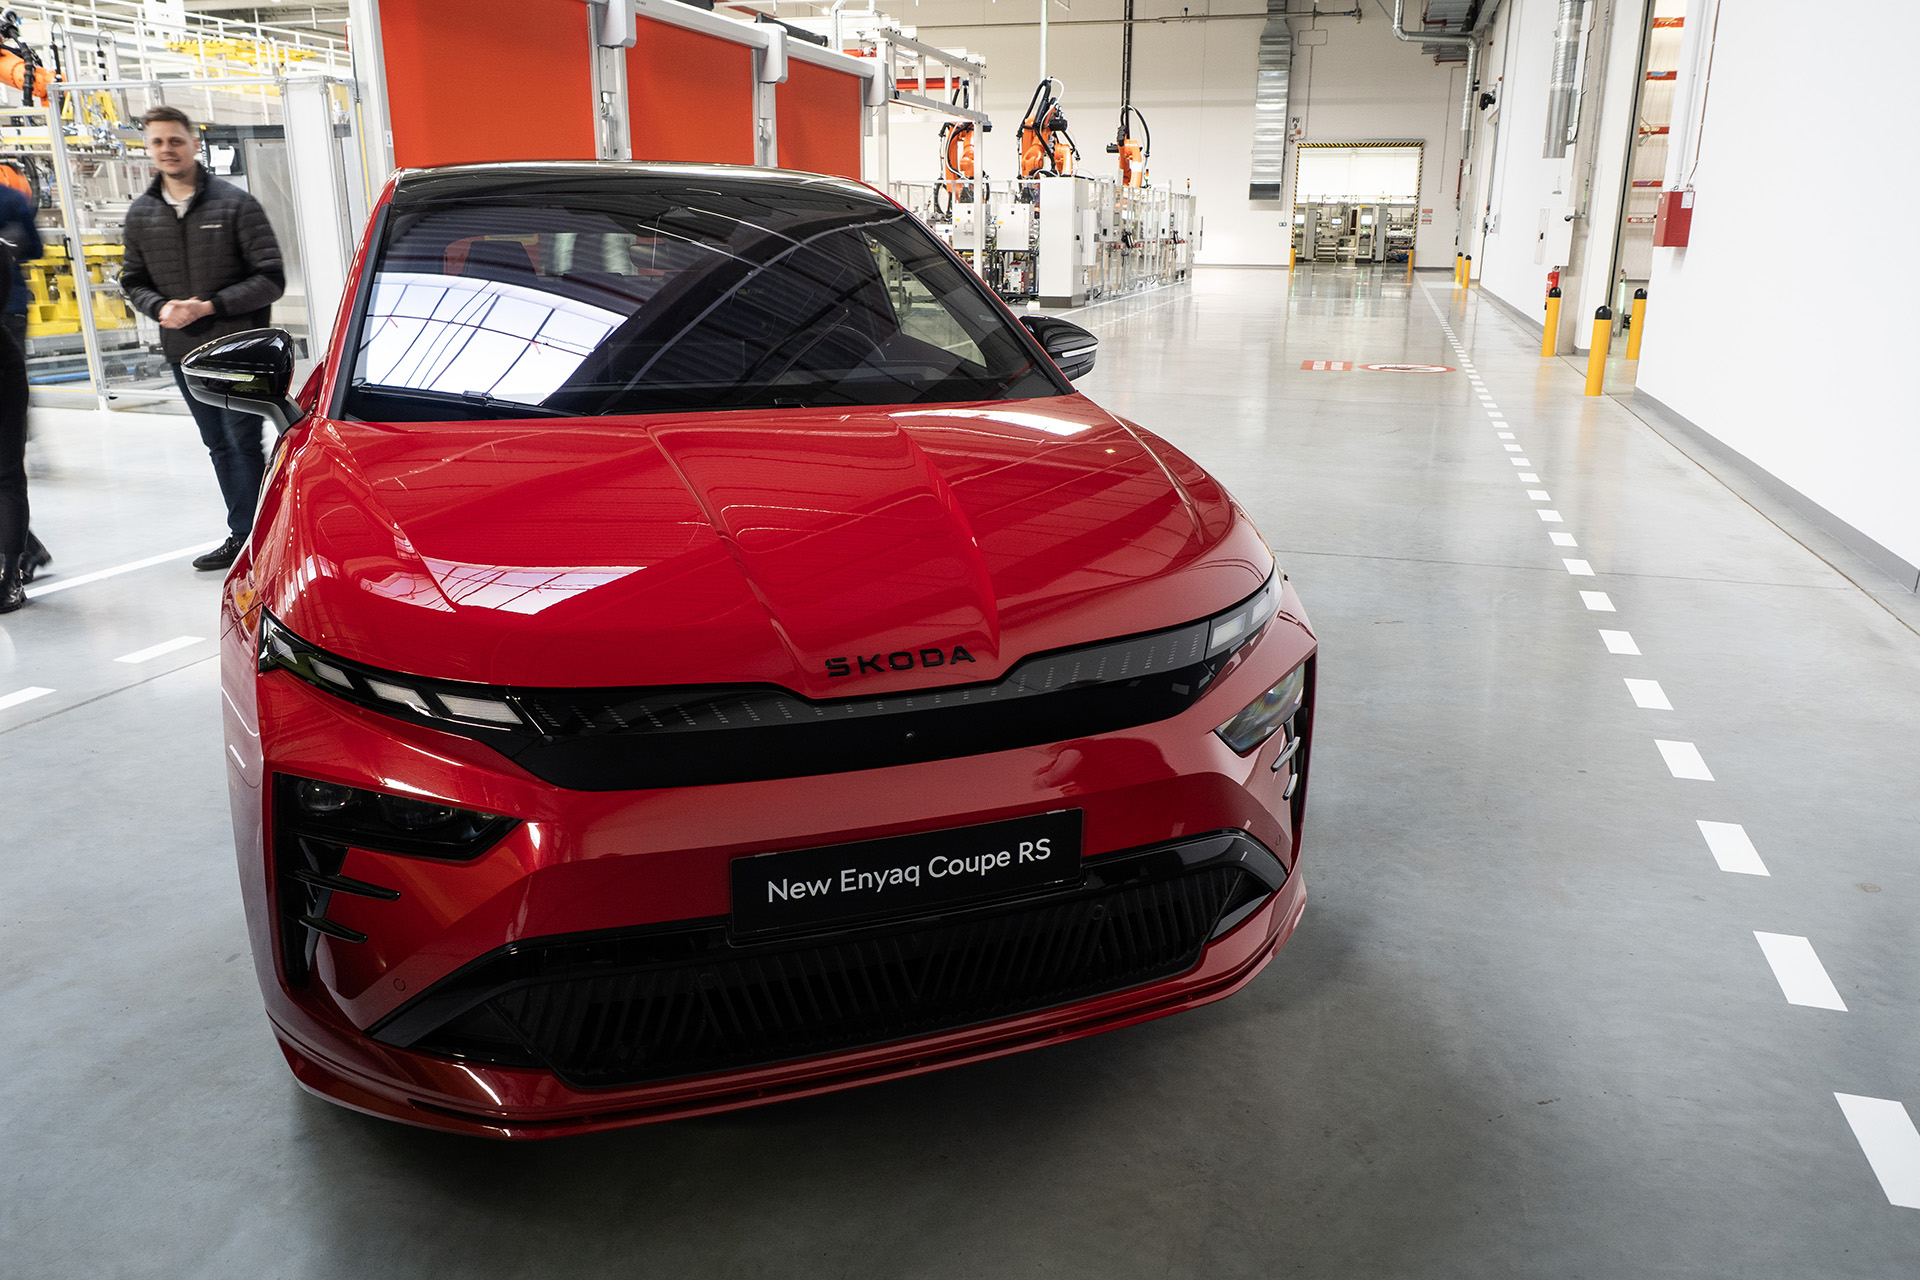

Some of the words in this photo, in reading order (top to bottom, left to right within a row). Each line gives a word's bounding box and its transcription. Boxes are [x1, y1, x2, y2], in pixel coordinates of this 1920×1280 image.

[825, 645, 976, 677] SKODA
[768, 878, 832, 902] New
[840, 865, 920, 892] Enyaq
[928, 850, 1010, 876] Coupe
[1018, 838, 1051, 863] RS
